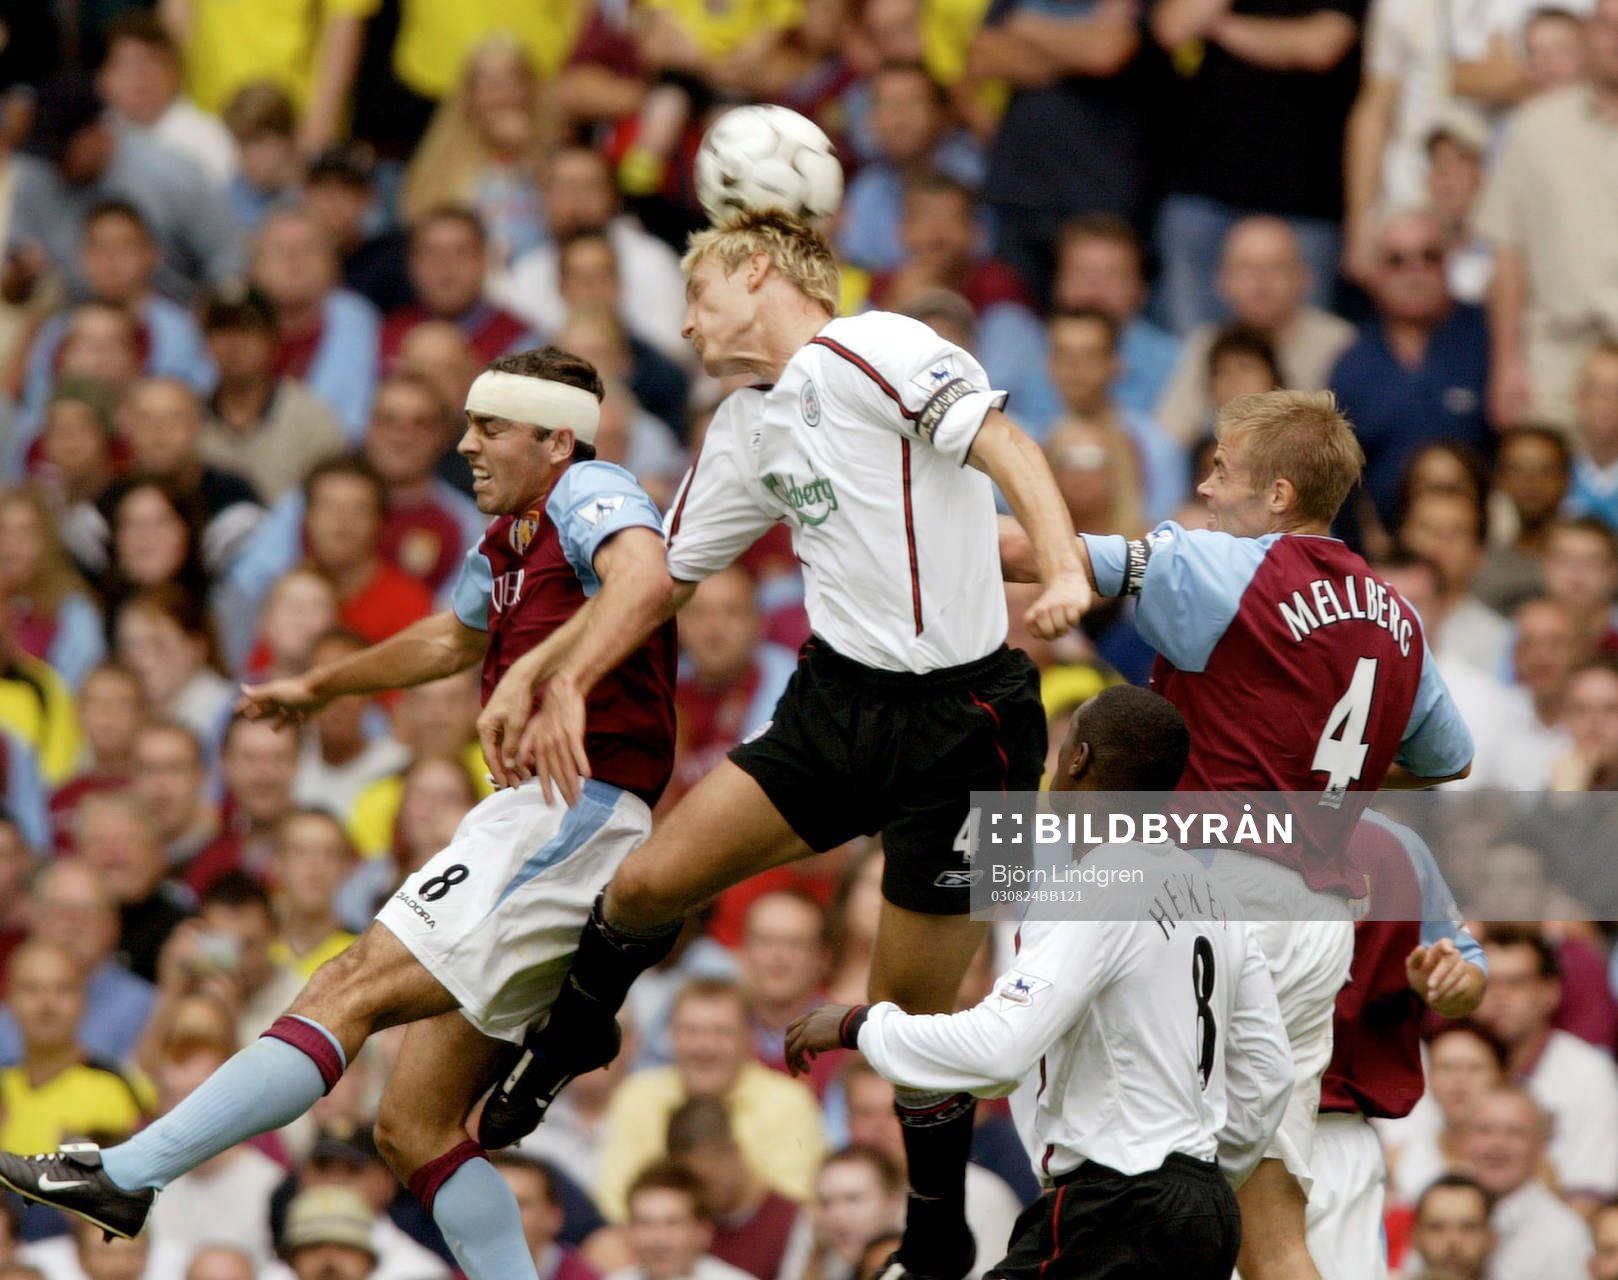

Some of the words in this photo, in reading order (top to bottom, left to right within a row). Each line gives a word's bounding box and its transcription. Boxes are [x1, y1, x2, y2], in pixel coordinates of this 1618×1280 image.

[1311, 656, 1378, 809] 4
[418, 863, 470, 902] 8
[952, 807, 982, 864] 4
[1193, 935, 1217, 1091] 8
